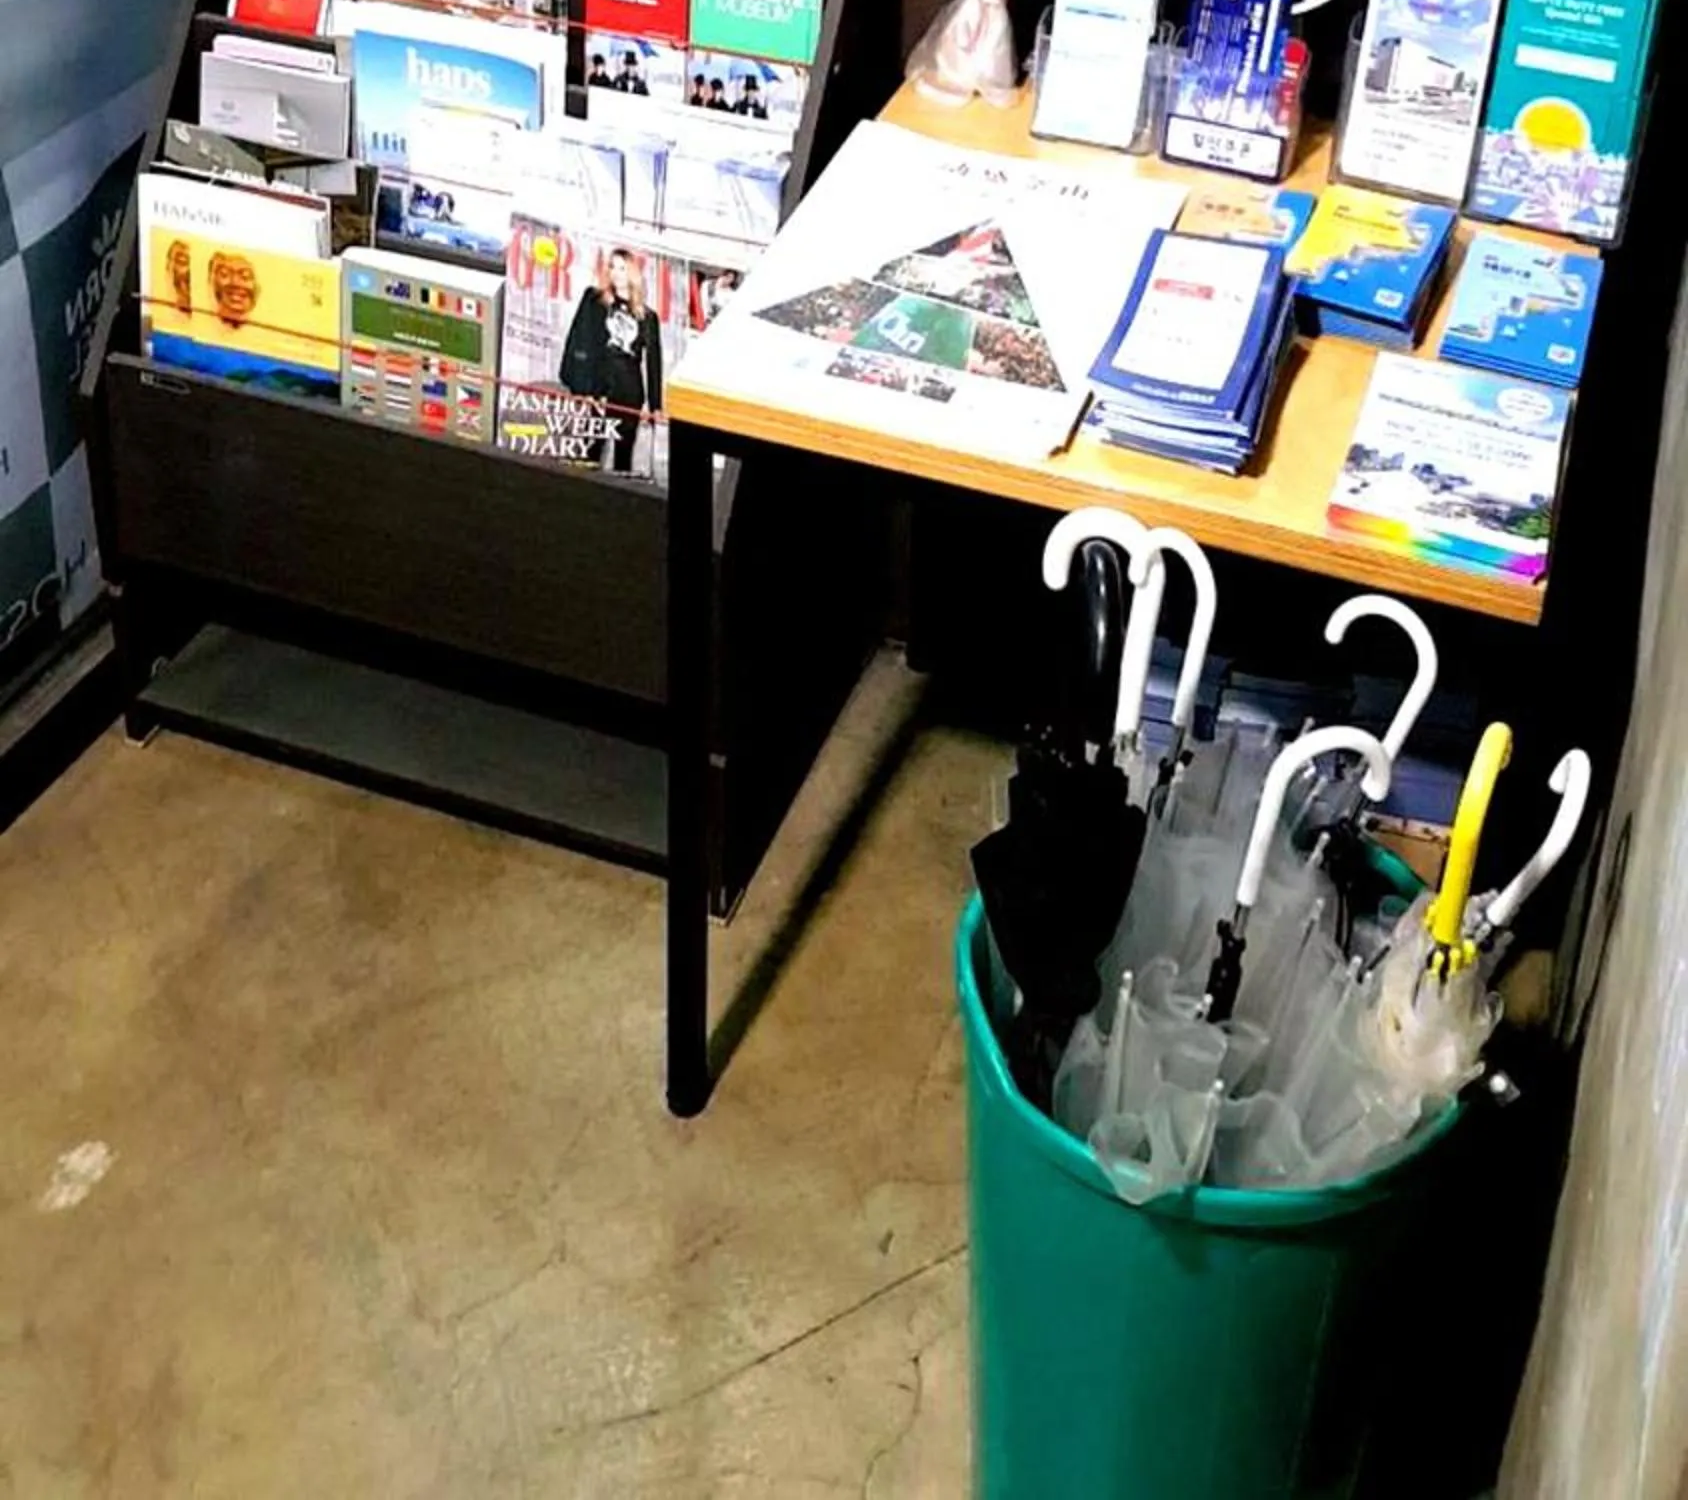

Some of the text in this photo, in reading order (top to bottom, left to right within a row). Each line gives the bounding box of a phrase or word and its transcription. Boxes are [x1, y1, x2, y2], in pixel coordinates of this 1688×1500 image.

[499, 384, 608, 417] FASHION
[544, 414, 622, 441] WEEK
[509, 432, 595, 459] DIARY
